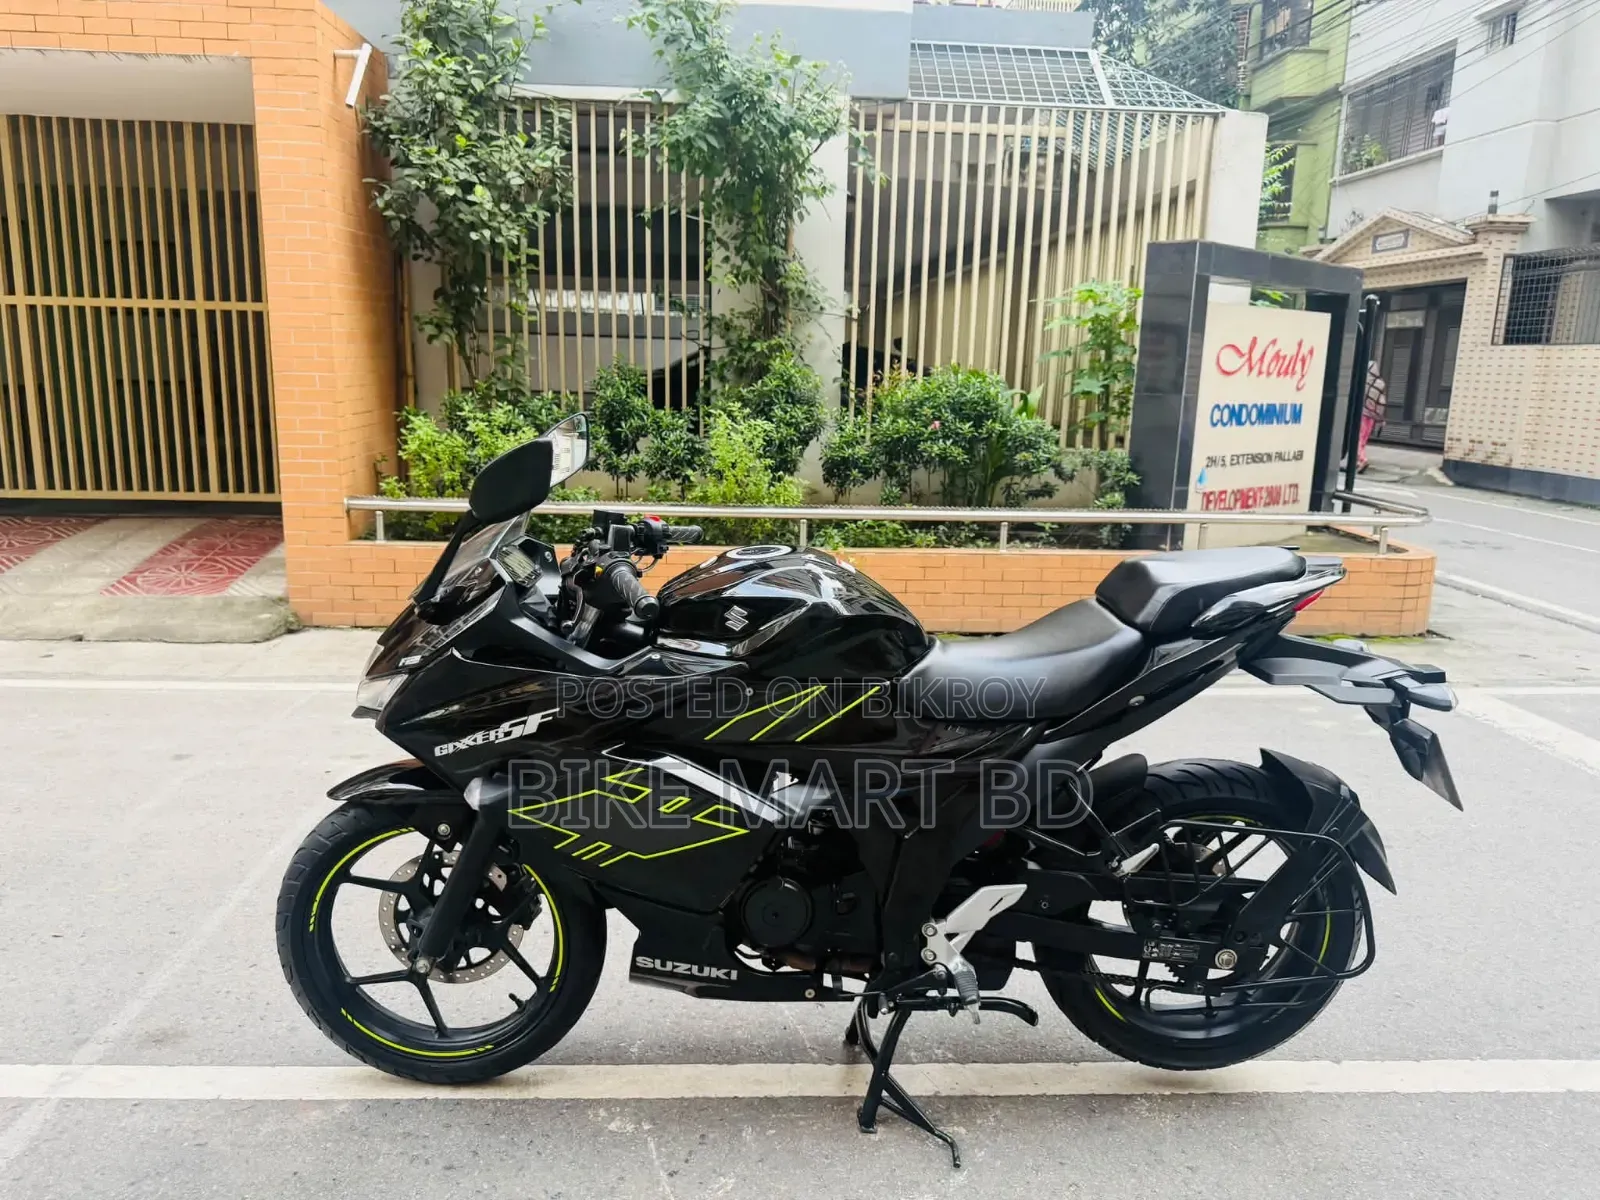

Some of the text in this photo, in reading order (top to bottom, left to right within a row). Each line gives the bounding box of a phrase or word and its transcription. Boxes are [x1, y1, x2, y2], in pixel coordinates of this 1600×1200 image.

[1215, 336, 1314, 392] Mouly
[1210, 403, 1303, 428] CONDOMINIUM
[1229, 452, 1273, 466] EXTENSION
[434, 726, 507, 757] GIXXER
[635, 956, 738, 981] SUZUKI
